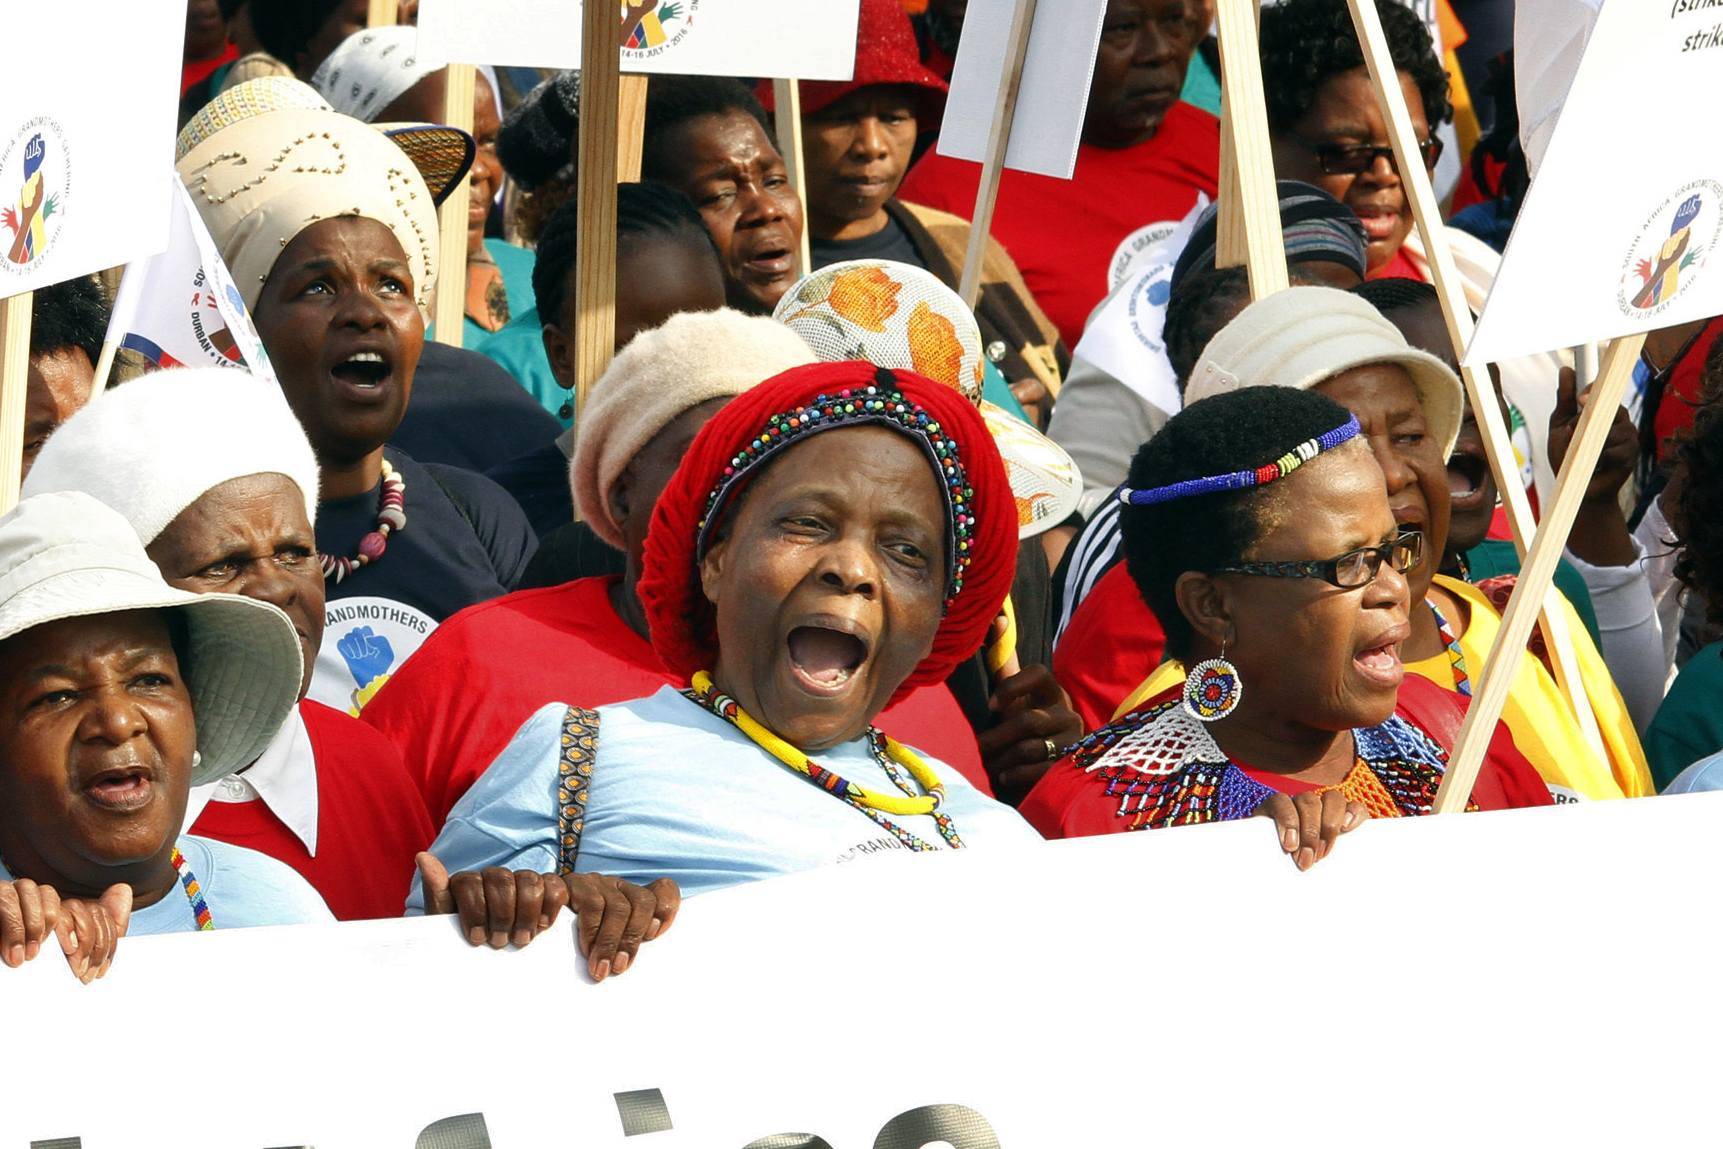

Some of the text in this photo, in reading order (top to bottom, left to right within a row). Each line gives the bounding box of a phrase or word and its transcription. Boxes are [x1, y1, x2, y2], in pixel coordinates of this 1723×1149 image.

[621, 49, 644, 59] 14-16
[646, 46, 664, 58] JULY
[191, 312, 212, 353] DURBAN
[323, 605, 428, 634] ANDMOTHERS
